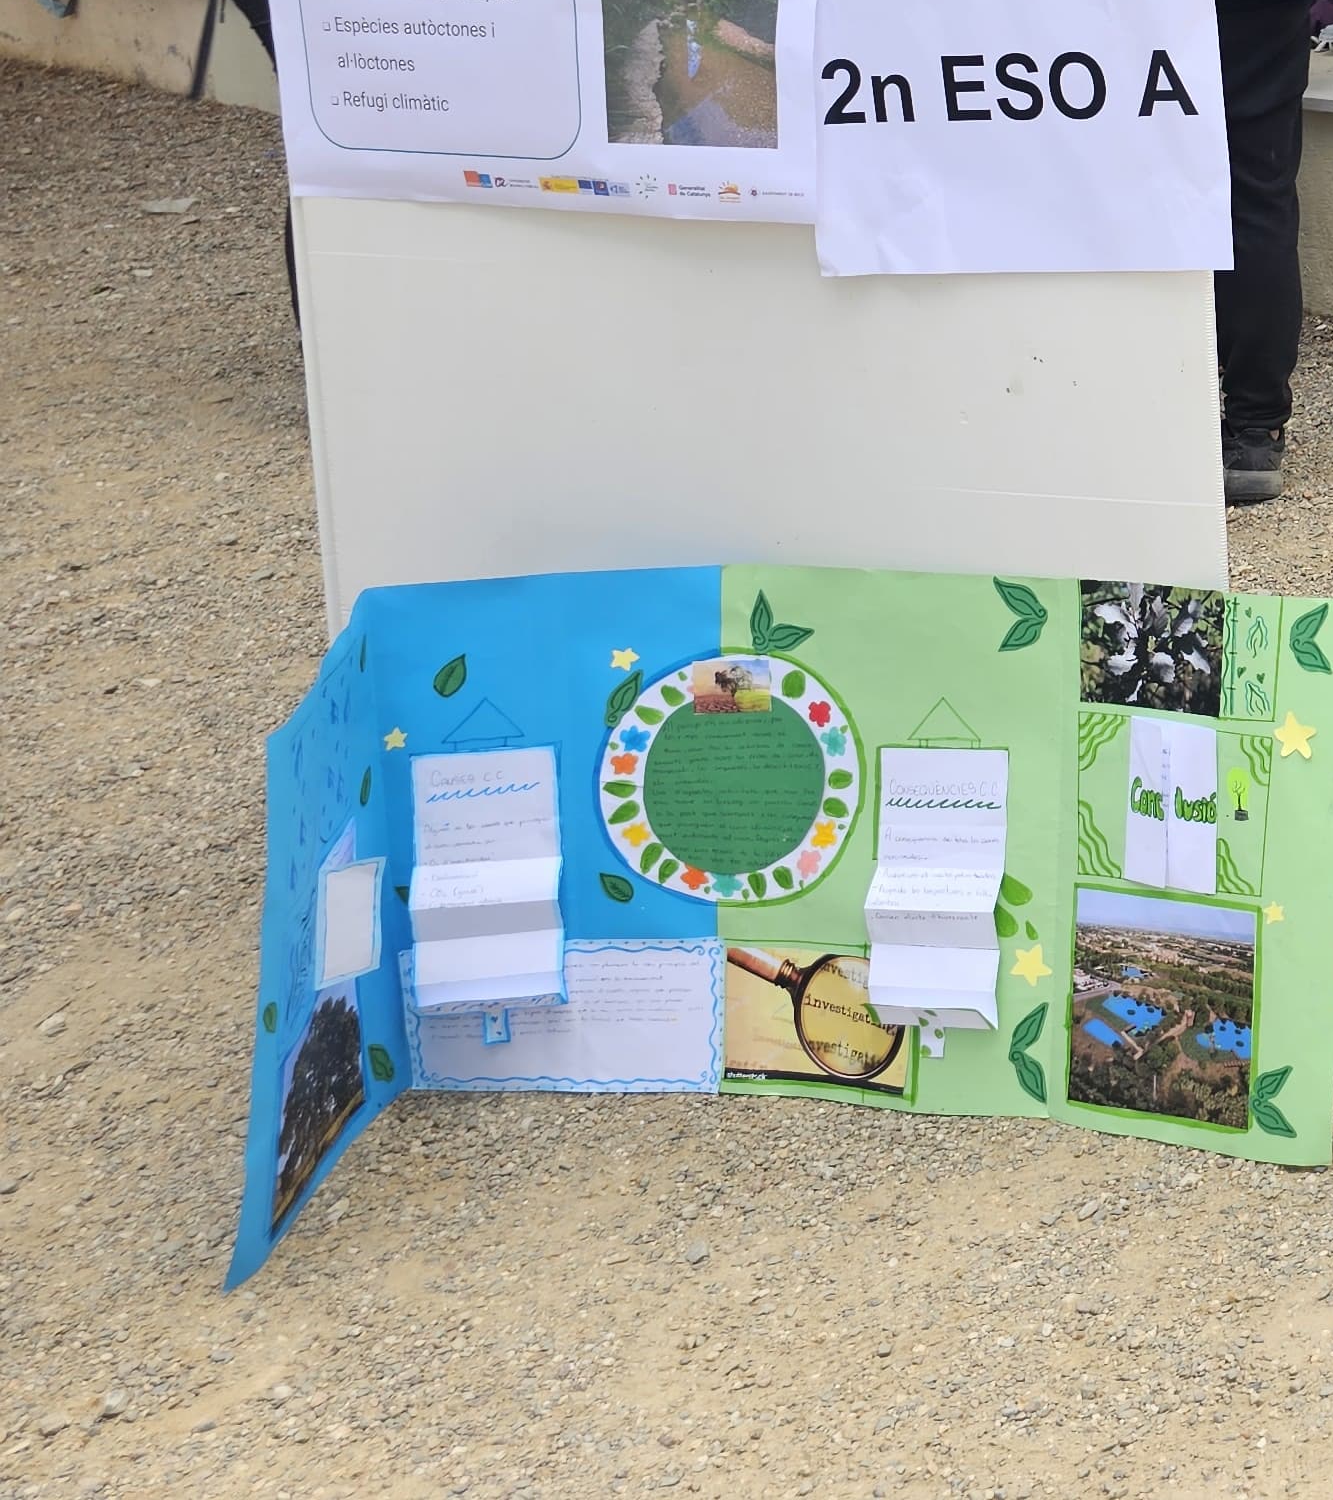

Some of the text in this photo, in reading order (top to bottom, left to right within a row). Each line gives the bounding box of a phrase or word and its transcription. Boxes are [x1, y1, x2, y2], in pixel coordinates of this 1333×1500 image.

[334, 17, 496, 38] Espècies autòctones i
[337, 52, 416, 72] al·lòctones
[820, 49, 1200, 126] 2n ESO A
[343, 91, 450, 112] Refugi climàtic
